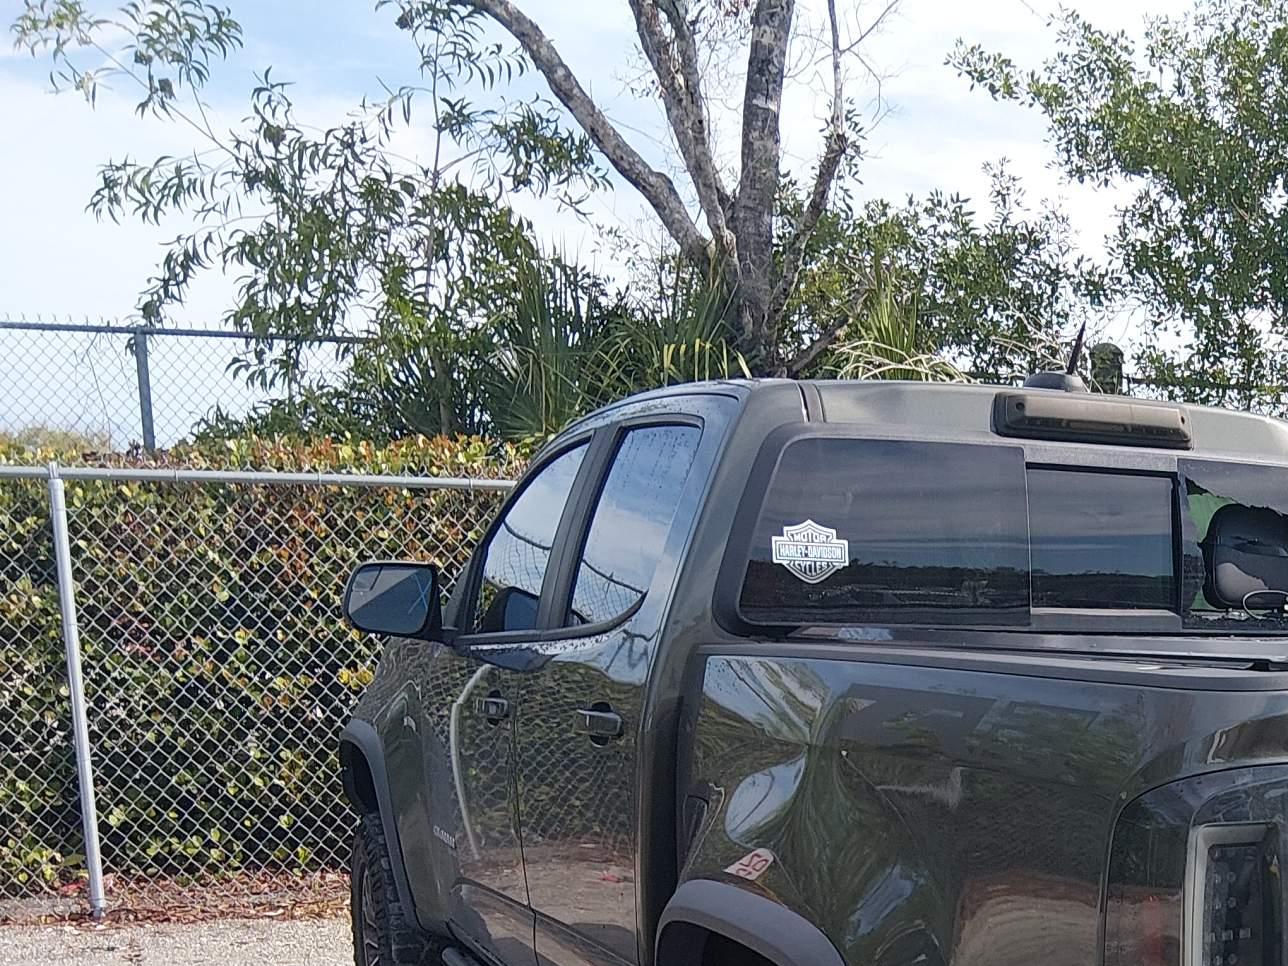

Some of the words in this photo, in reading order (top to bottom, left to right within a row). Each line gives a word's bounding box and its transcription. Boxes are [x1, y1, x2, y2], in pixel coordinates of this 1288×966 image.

[793, 530, 827, 544] MOTOR
[779, 544, 842, 559] HARLEY-DAVIDSON
[794, 561, 828, 576] CYCLES
